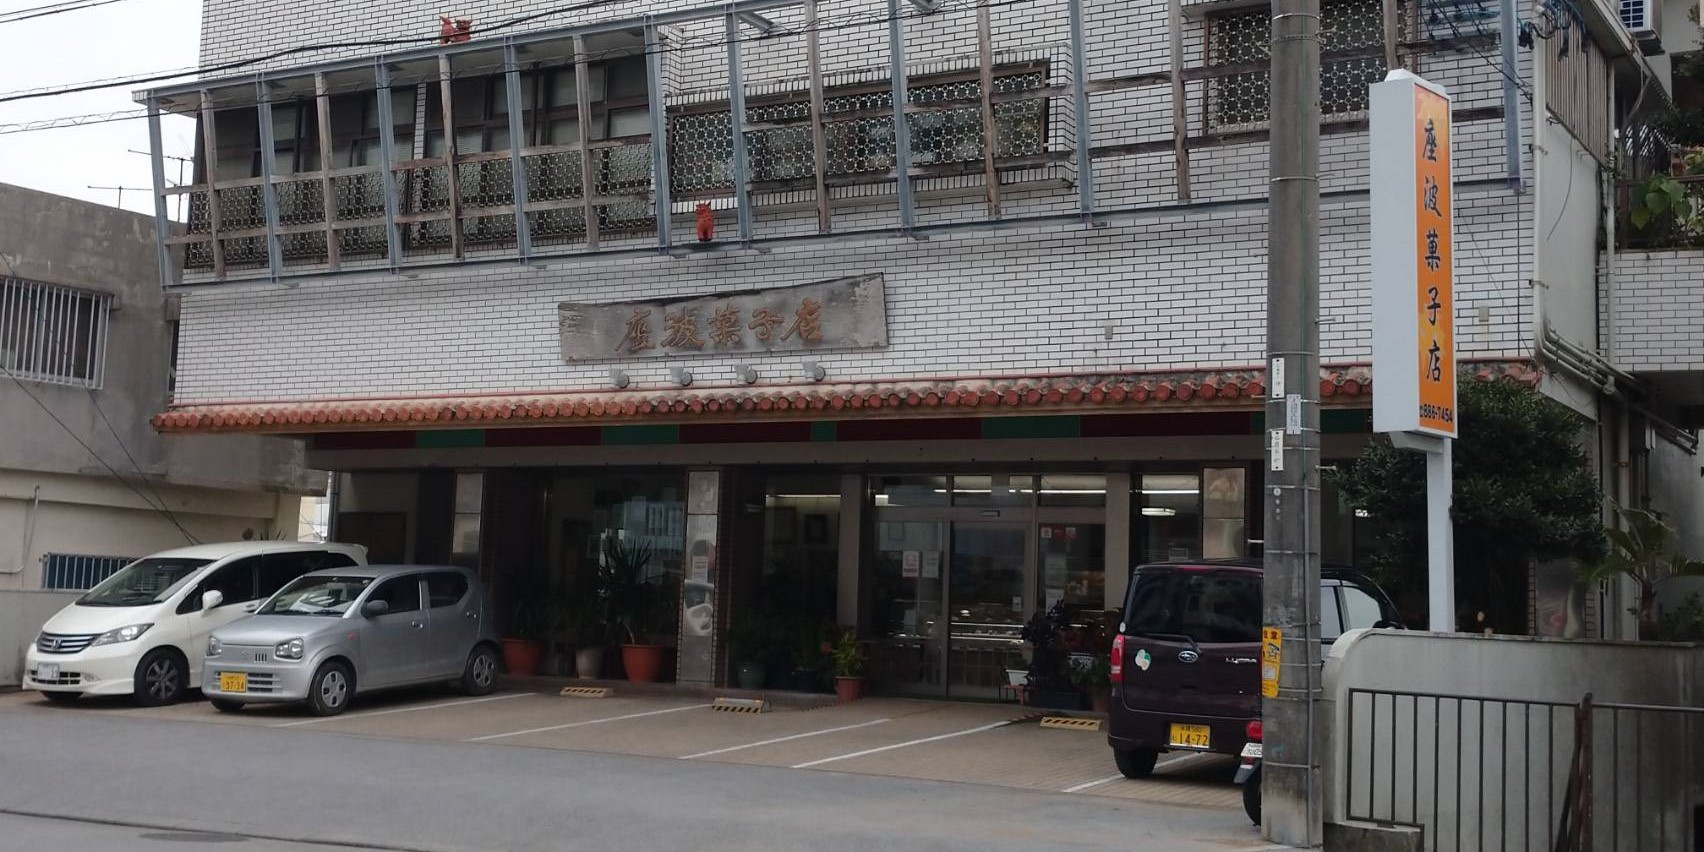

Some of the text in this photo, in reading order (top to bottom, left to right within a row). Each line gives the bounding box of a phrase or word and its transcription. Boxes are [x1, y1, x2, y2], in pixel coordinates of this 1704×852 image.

[1422, 118, 1442, 383] 座波菓子店
[614, 297, 824, 352] 座波菓子店
[1179, 732, 1209, 746] 14-72
